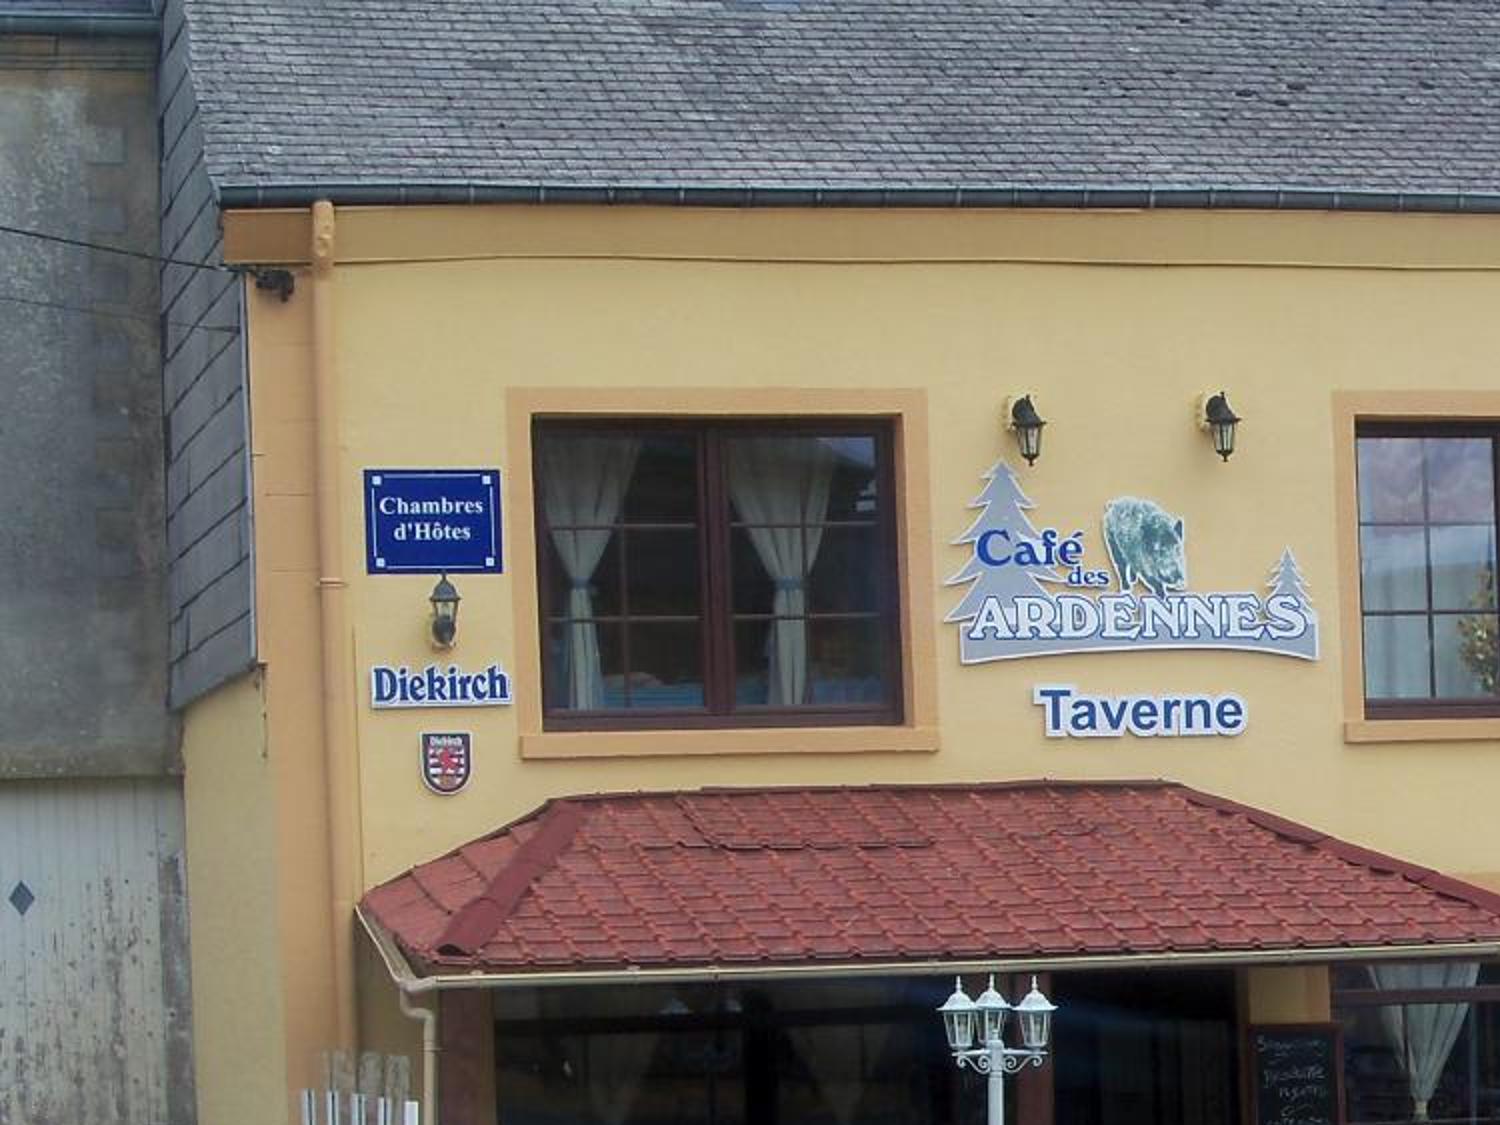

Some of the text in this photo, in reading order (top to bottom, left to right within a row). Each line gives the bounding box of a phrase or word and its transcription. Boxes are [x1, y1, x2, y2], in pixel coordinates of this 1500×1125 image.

[379, 497, 483, 515] Chambres
[393, 521, 471, 541] d'Hôtes
[977, 529, 1084, 567] Café
[1067, 565, 1110, 586] des
[968, 593, 1311, 641] ARDENNES
[373, 664, 508, 701] Diekirch
[1039, 689, 1243, 731] Taverne
